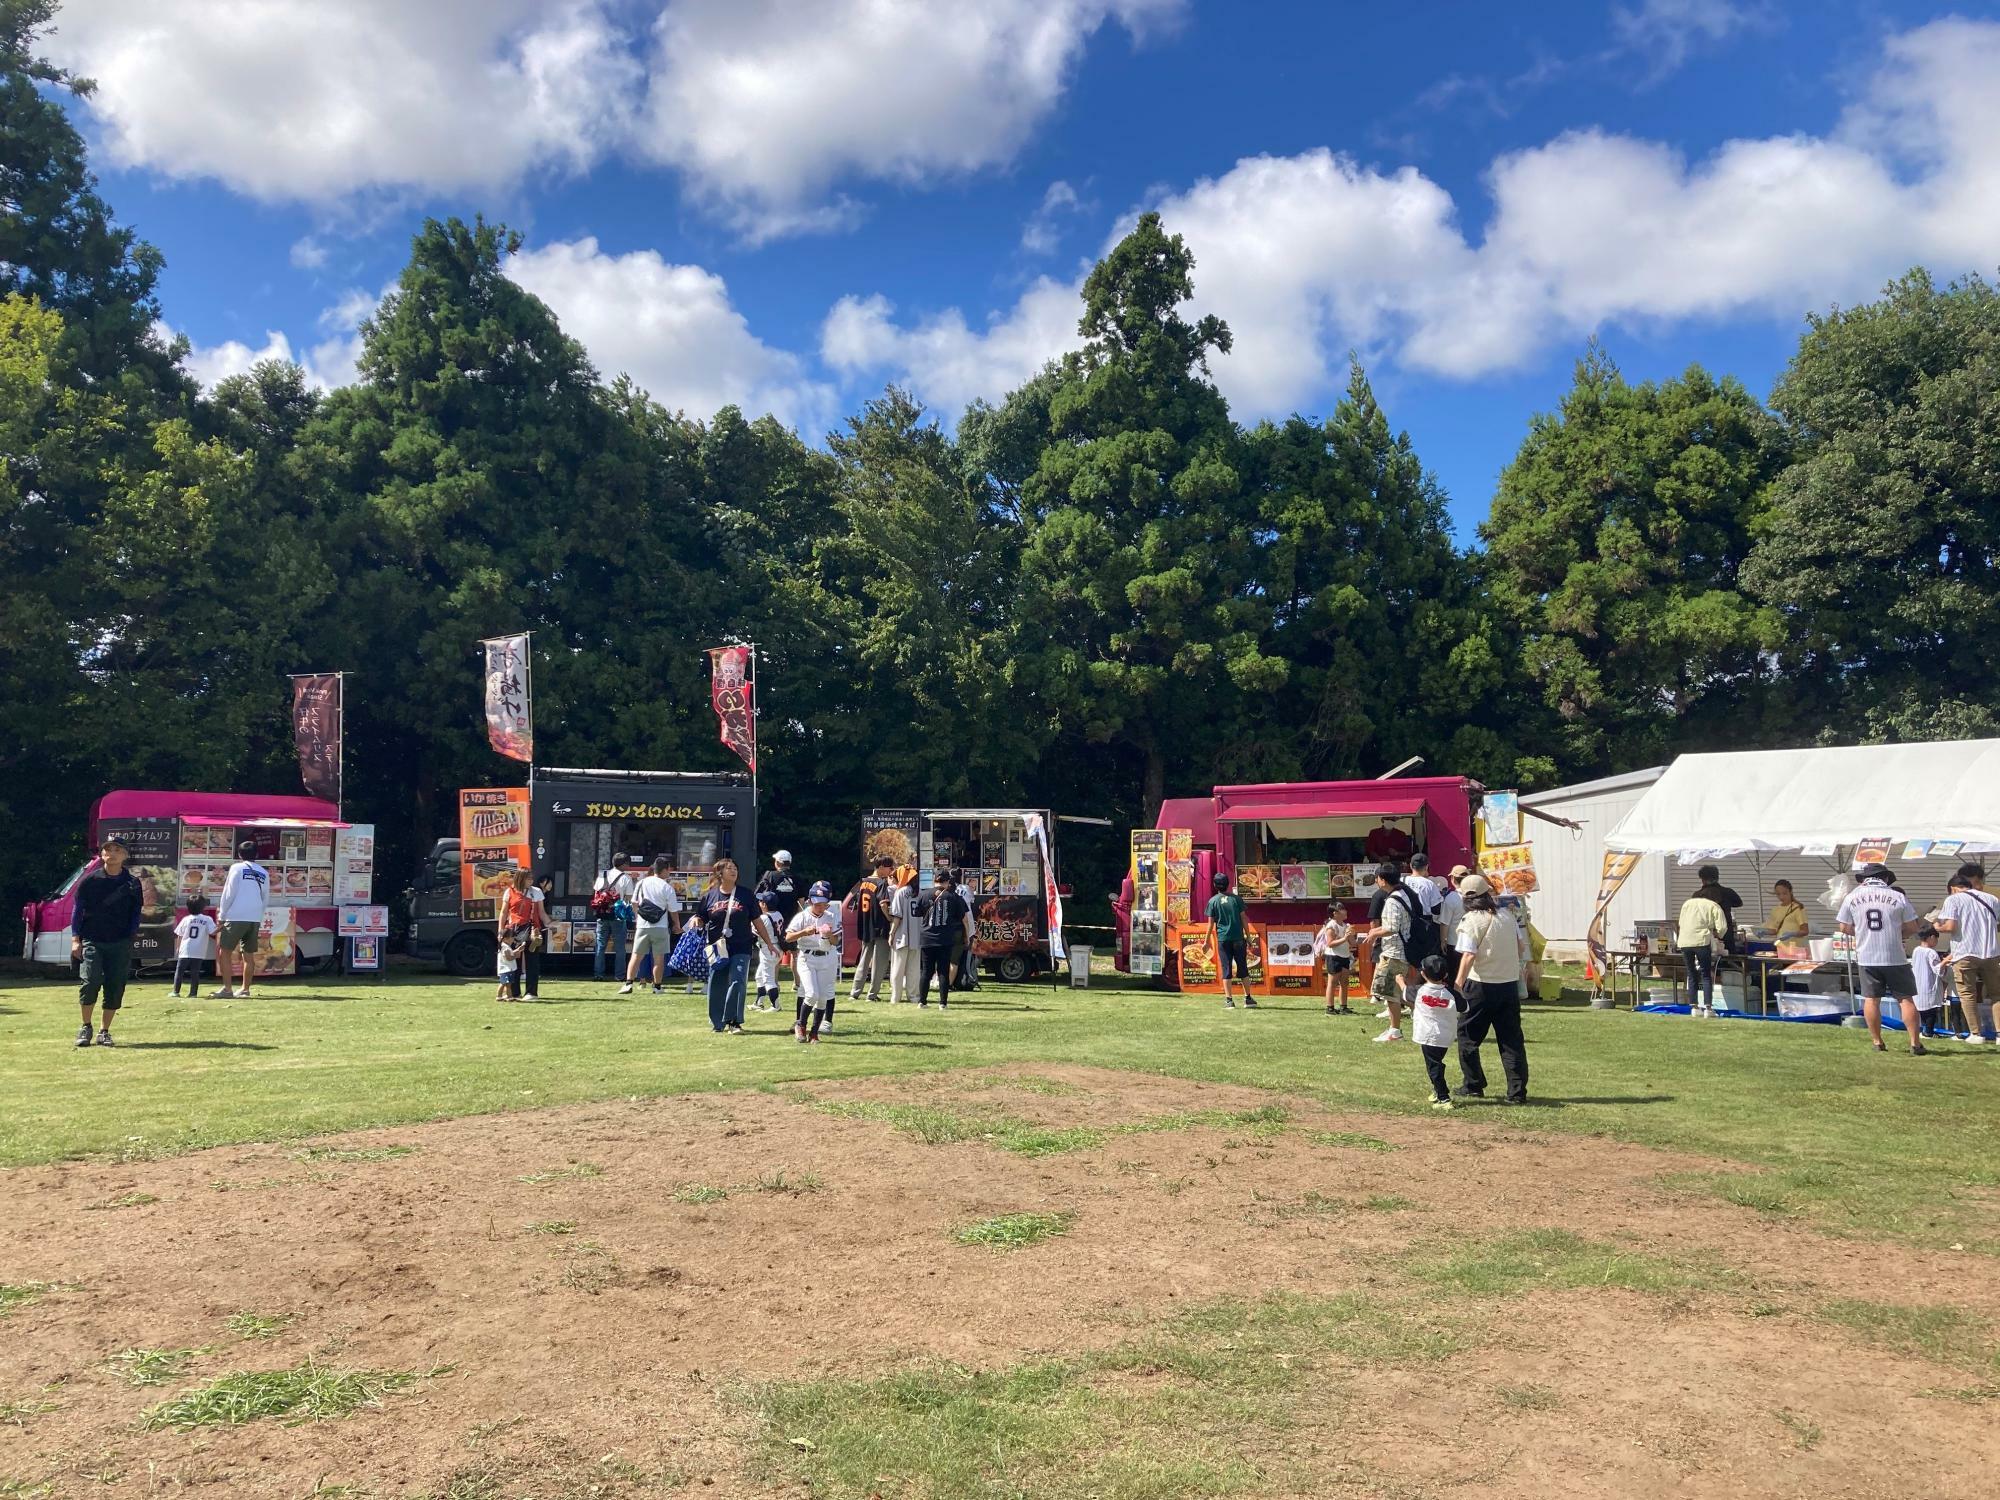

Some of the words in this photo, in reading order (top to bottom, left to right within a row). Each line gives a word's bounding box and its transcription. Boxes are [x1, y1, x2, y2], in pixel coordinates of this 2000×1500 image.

[586, 803, 703, 819] ガツンとにんにく
[464, 849, 507, 860] からあげ
[862, 893, 871, 913] 6
[1850, 894, 1898, 909] NAKAMURA
[1866, 909, 1883, 931] 8
[142, 939, 158, 948] Rib
